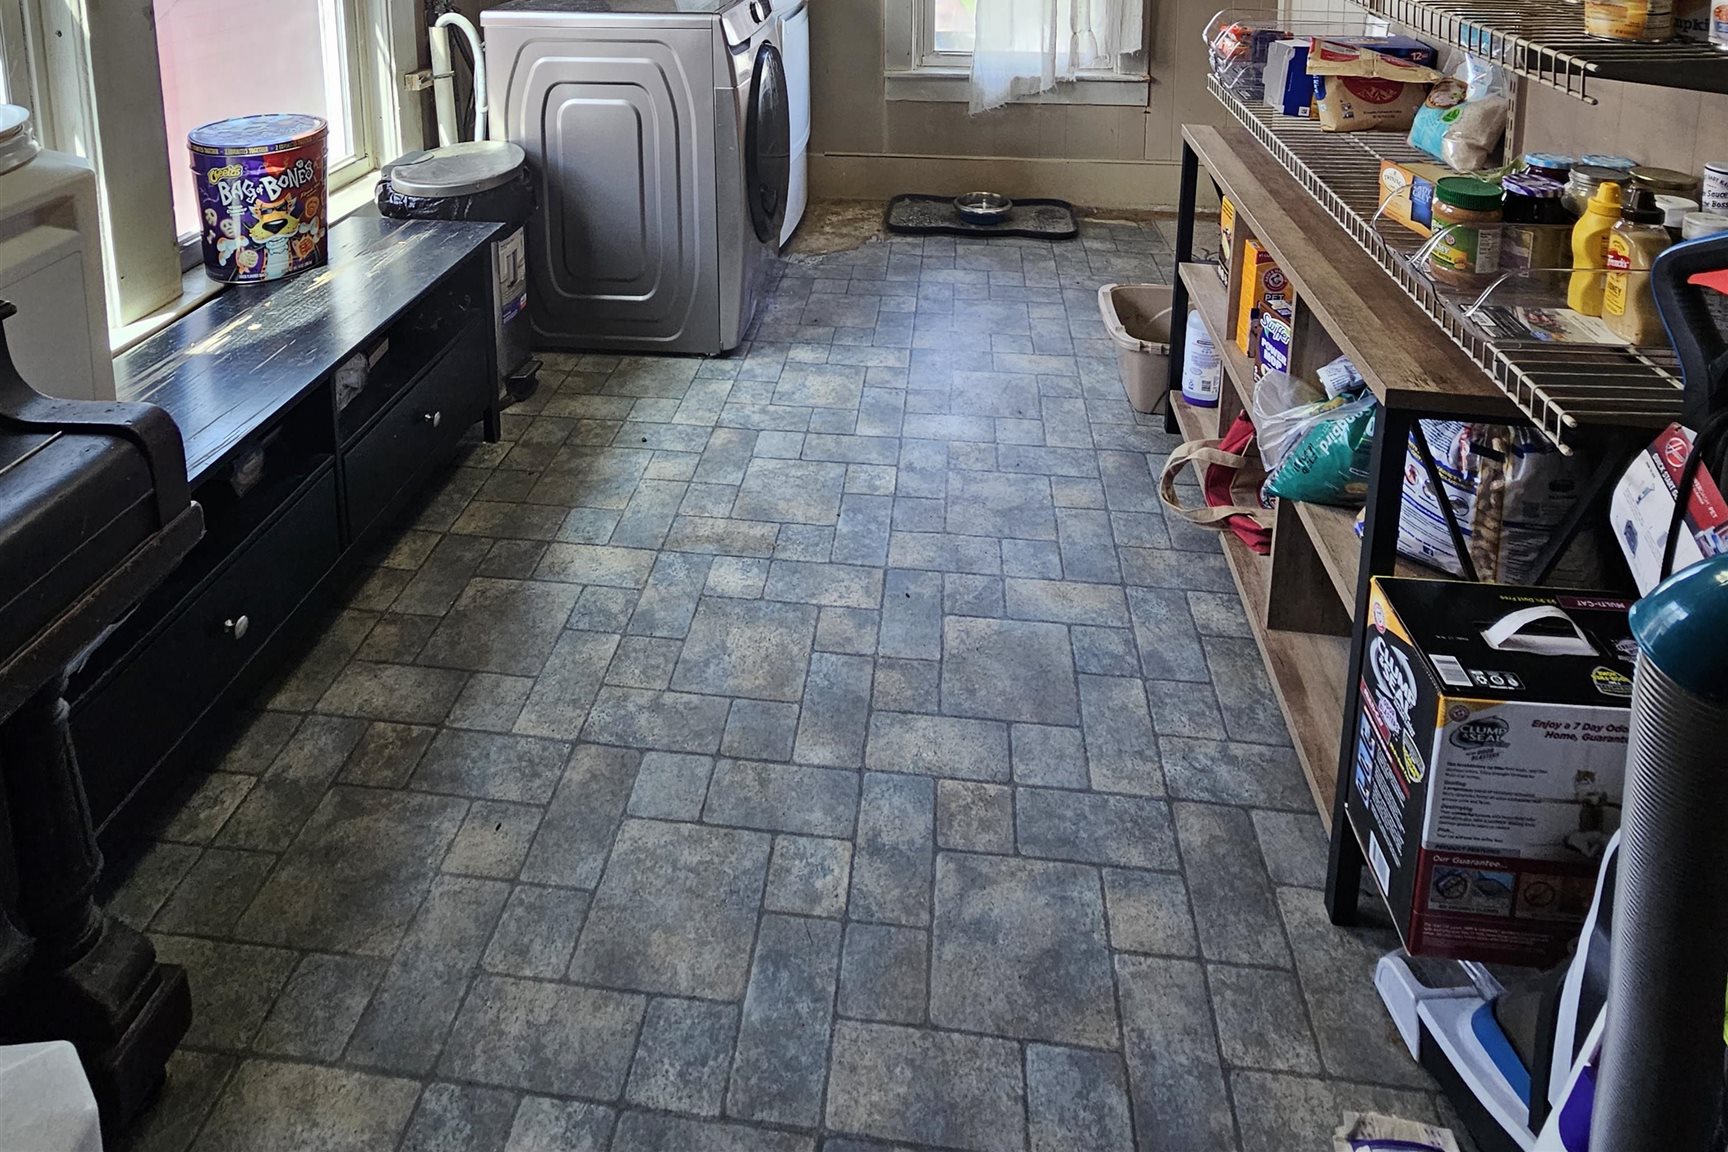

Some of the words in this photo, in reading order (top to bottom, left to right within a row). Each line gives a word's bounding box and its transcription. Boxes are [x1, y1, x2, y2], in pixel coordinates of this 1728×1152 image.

[209, 165, 243, 184] Cheetos
[218, 179, 258, 206] BAG
[256, 183, 265, 195] of
[261, 160, 314, 201] BONES
[1261, 312, 1292, 345] Swiffer
[1261, 337, 1288, 367] POWER
[1262, 353, 1284, 372] MOP
[1652, 452, 1665, 472] QUICK
[1662, 471, 1676, 492] START
[1577, 600, 1626, 609] MULTI-CAT
[1459, 725, 1508, 736] CLUMP
[1532, 719, 1562, 730] Enjoy
[1573, 722, 1580, 730] 7
[1582, 723, 1604, 733] Day
[1606, 724, 1629, 733] Odo
[1469, 734, 1503, 743] SEAL
[1544, 730, 1578, 742] Home,
[1581, 733, 1629, 743] Guarante
[1432, 855, 1450, 863] Our
